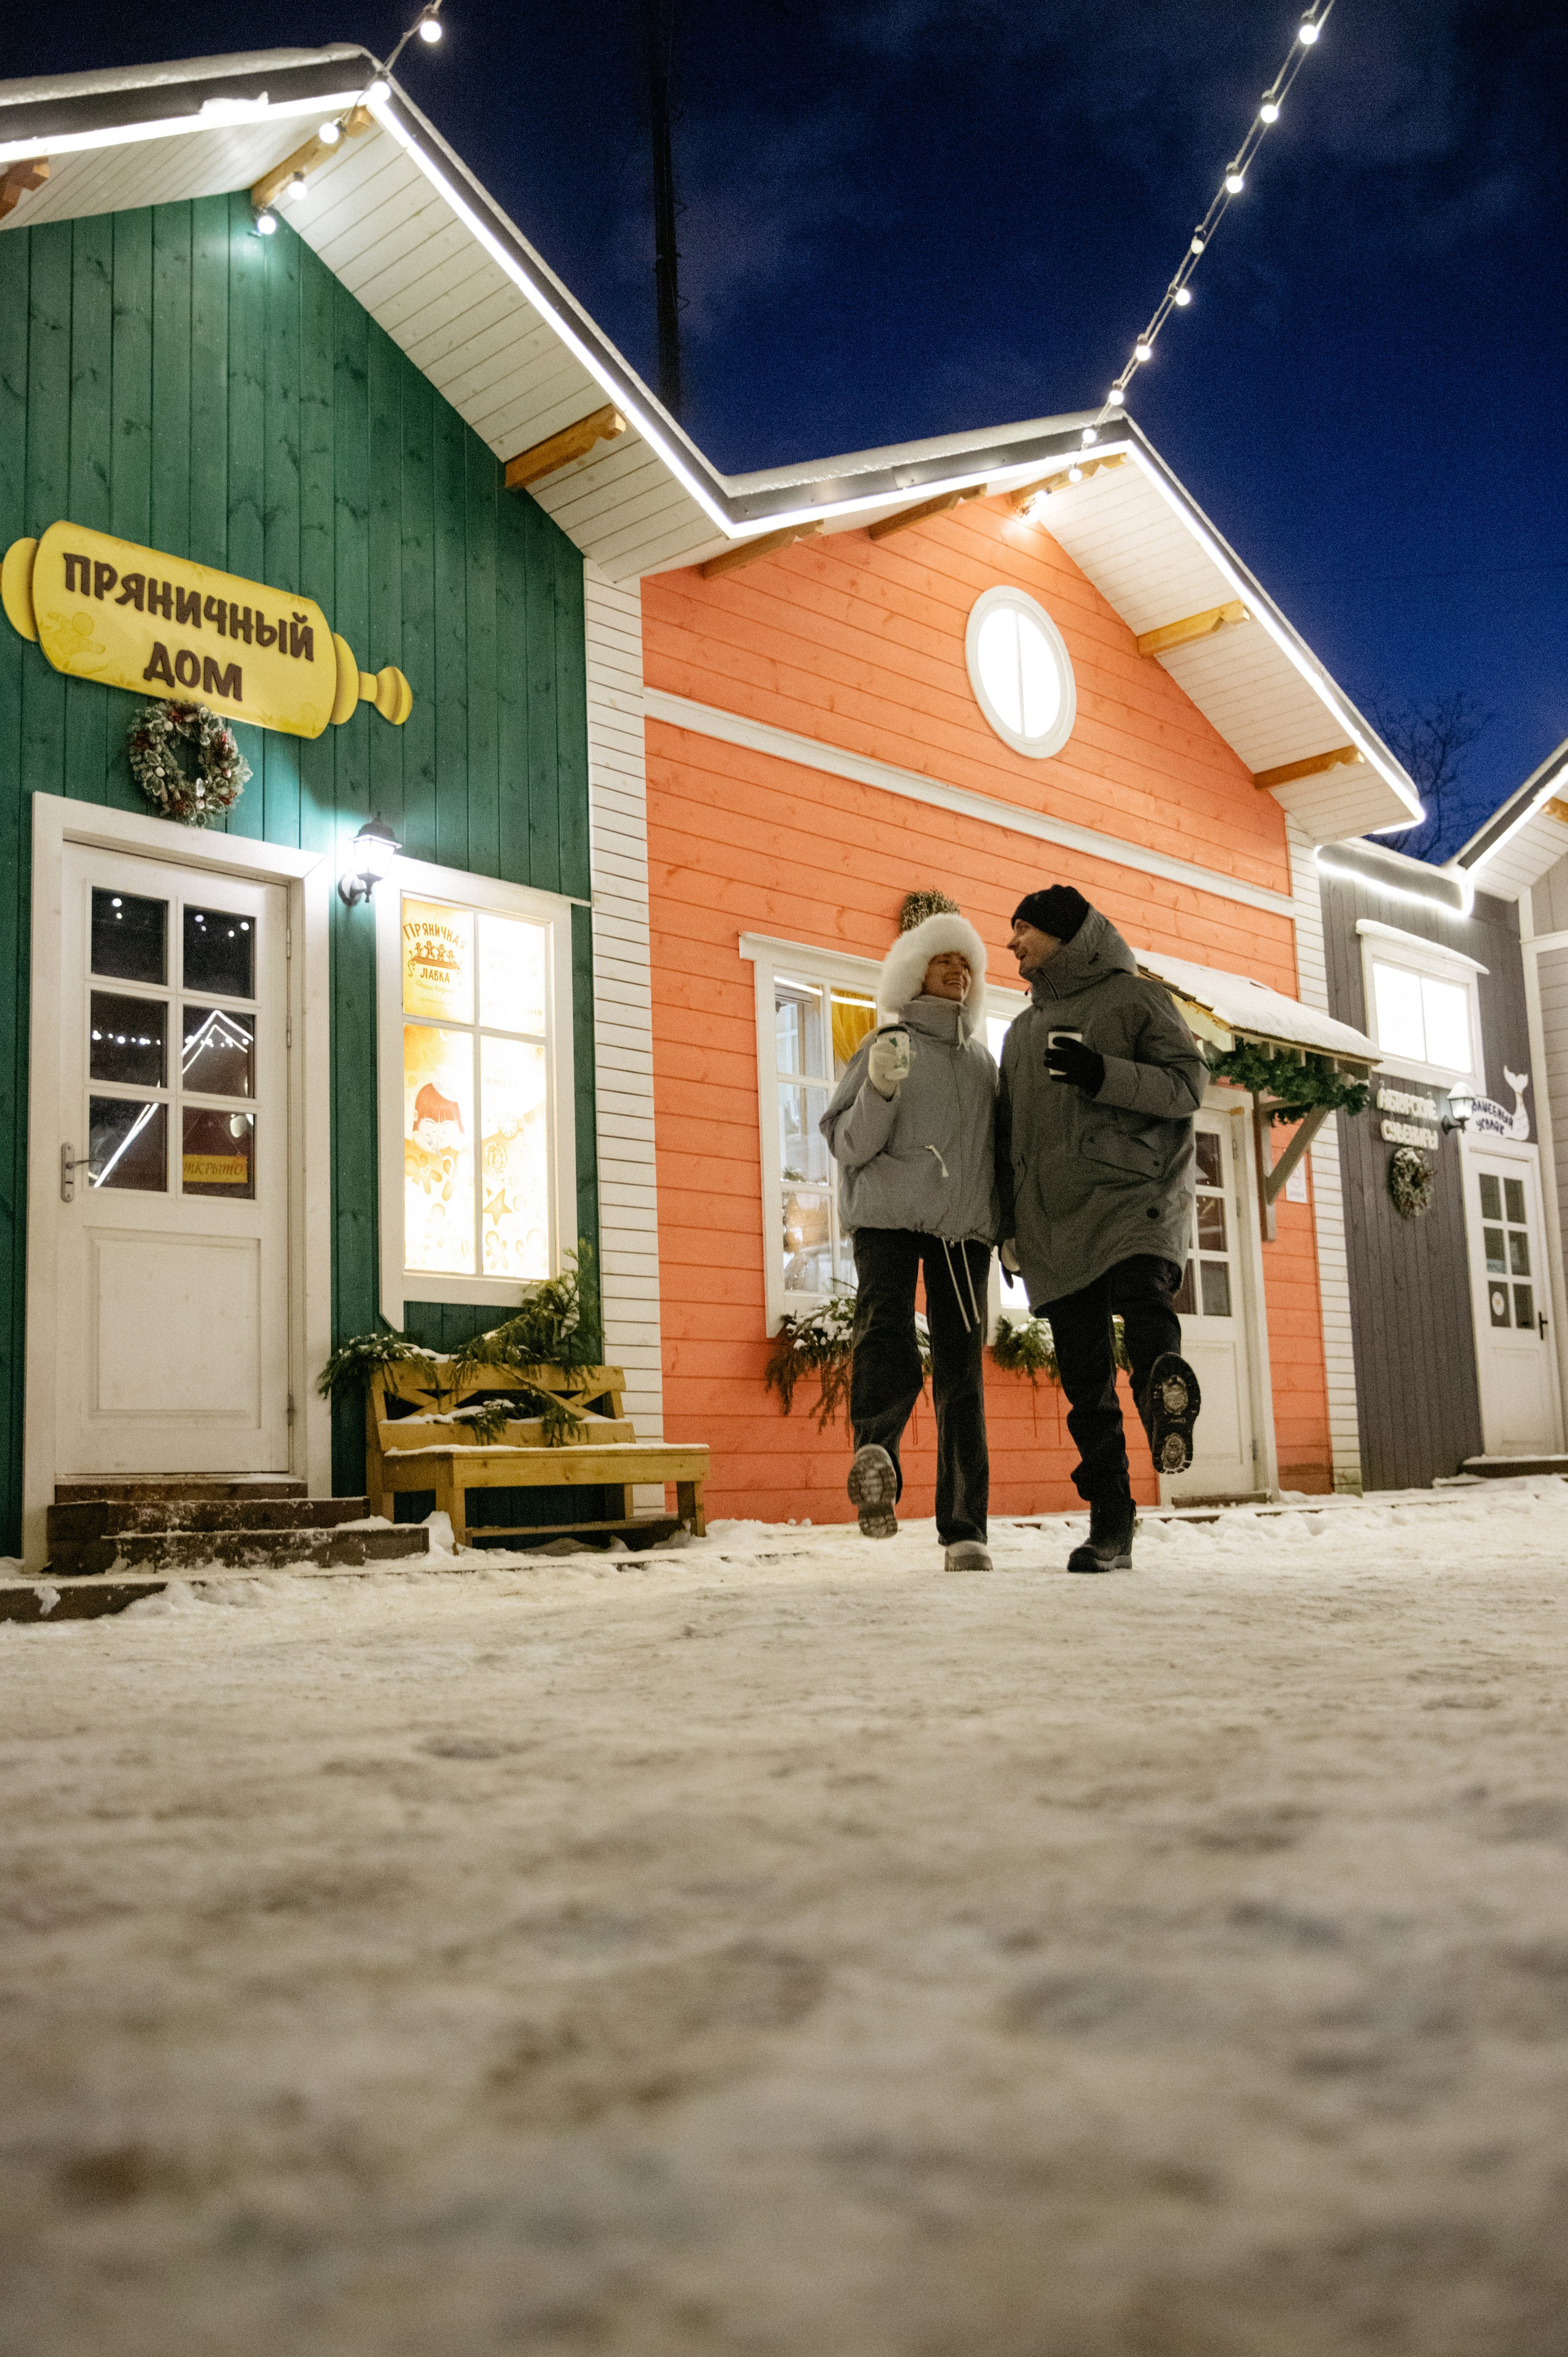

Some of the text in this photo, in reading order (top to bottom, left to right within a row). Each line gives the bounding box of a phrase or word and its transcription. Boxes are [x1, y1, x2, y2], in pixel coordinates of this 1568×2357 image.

[63, 552, 315, 662] ПРЯНИЧНЫЙ
[143, 641, 243, 701] ДОМ
[403, 922, 467, 951] ПРЯНИЧНАЯ
[420, 968, 450, 983] ЛАВКА
